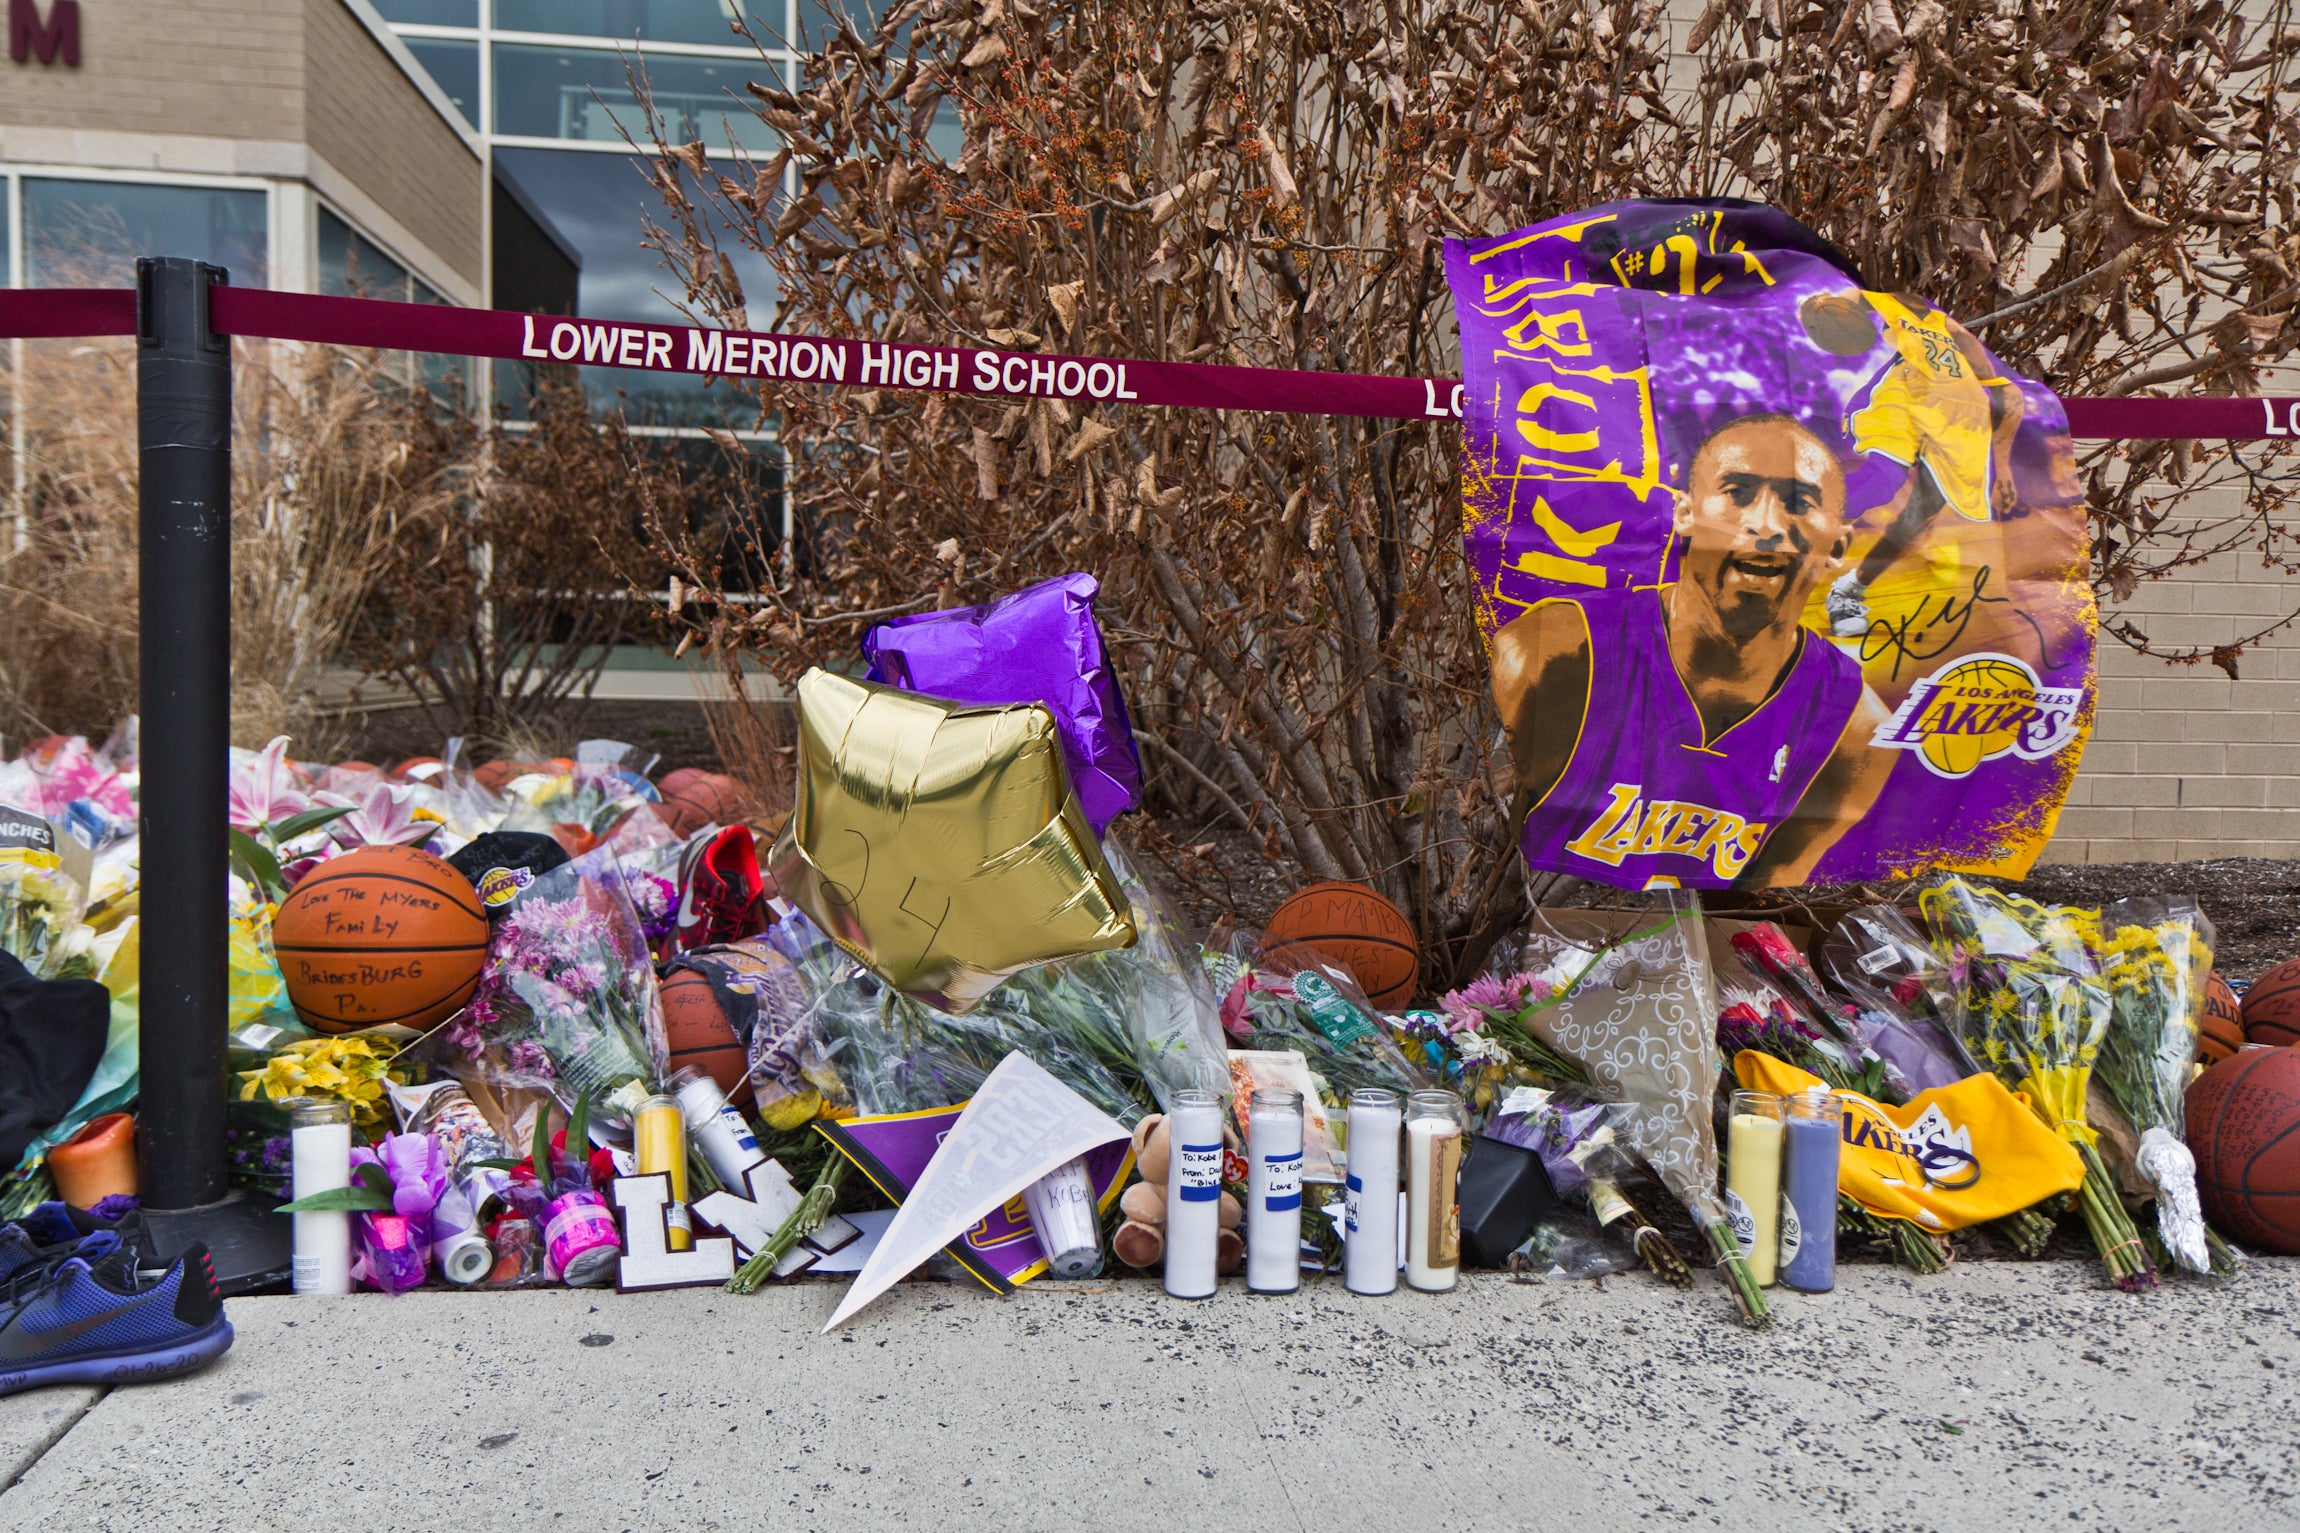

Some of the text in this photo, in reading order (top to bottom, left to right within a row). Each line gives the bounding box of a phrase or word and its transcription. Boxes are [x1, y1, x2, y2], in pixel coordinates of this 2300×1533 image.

[9, 0, 80, 66] M
[522, 315, 1138, 399] LOWER MERION HIGH SCHOOL
[1921, 337, 1962, 378] 24
[1954, 686, 2075, 706] LOS ANGELES
[1881, 684, 2071, 754] LAKERS
[1564, 782, 1768, 880] LAKERS
[337, 888, 367, 901] THE
[820, 828, 951, 970] 24
[1326, 894, 1407, 936] MAMBA
[1181, 1166, 1205, 1177] From:
[1182, 1151, 1216, 1162] To: Kobe
[1225, 1156, 1243, 1181] ty
[1266, 1163, 1285, 1174] To:
[1269, 1180, 1296, 1191] Love:
